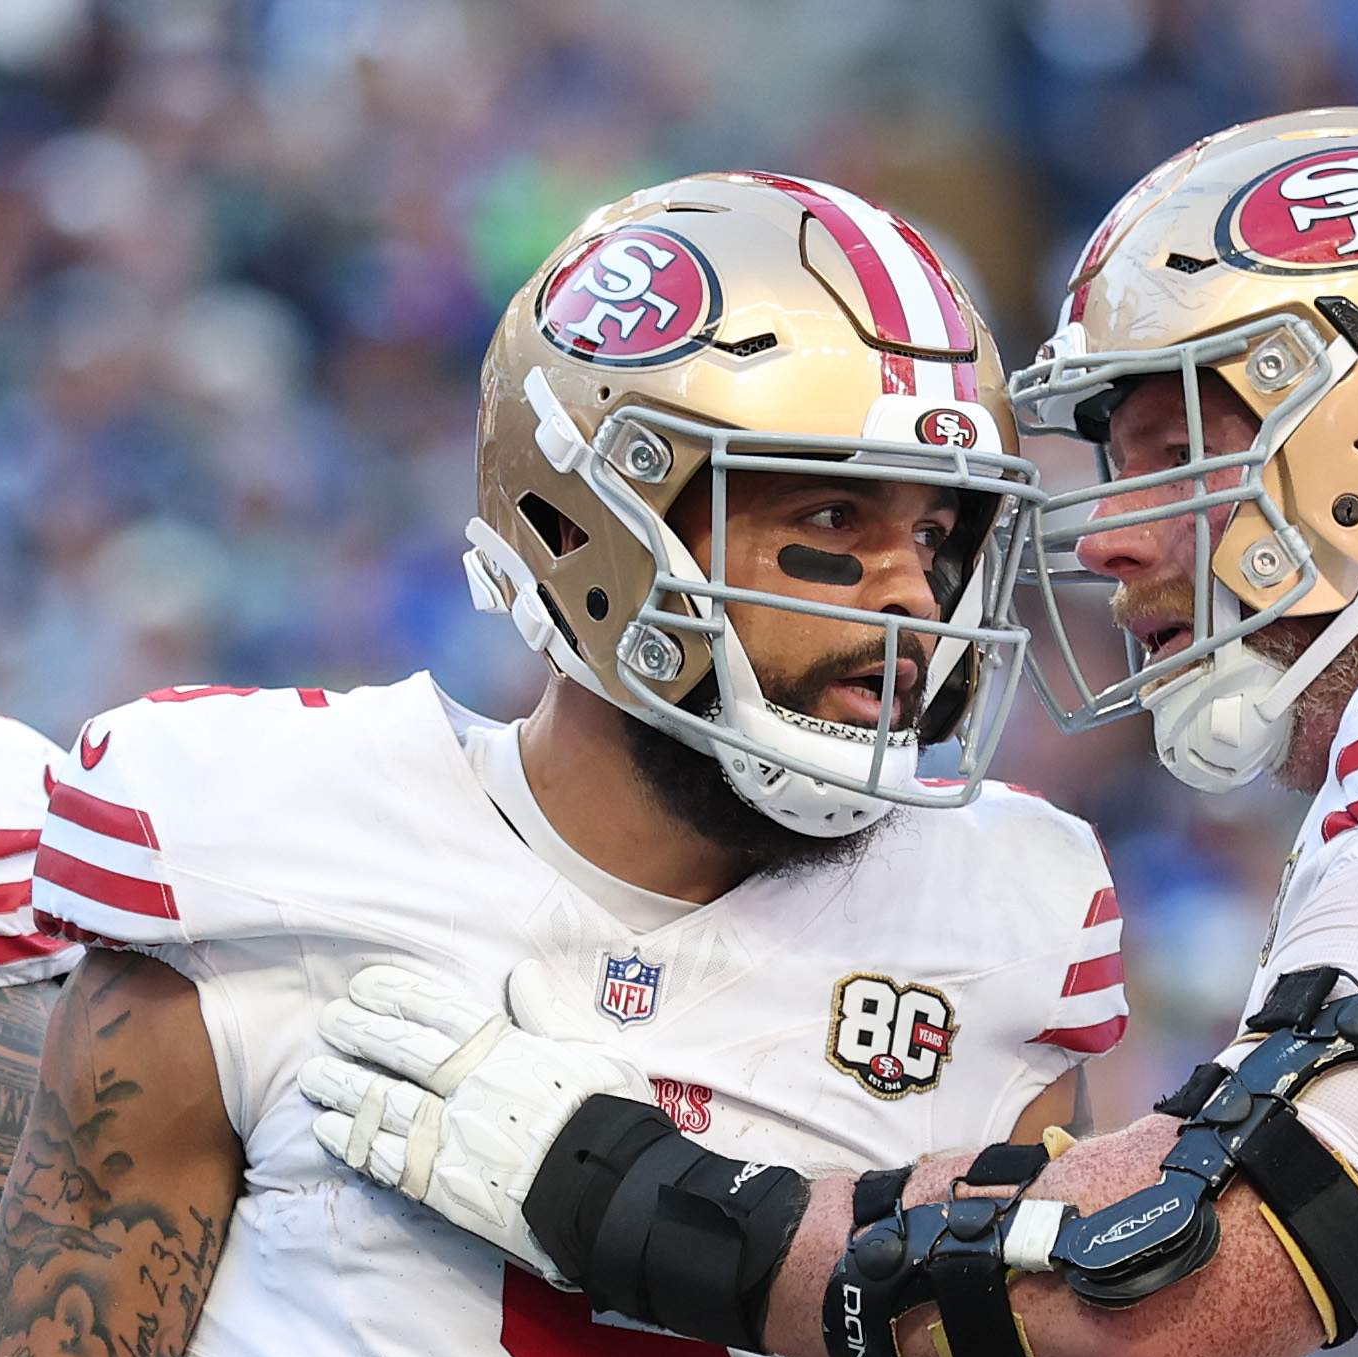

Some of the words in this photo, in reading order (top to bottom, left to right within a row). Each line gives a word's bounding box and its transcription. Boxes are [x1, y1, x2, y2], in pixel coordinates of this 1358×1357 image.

[565, 238, 680, 346] SF
[606, 982, 649, 1016] NFL
[918, 1027, 944, 1048] YEARS
[867, 1073, 884, 1089] EST.
